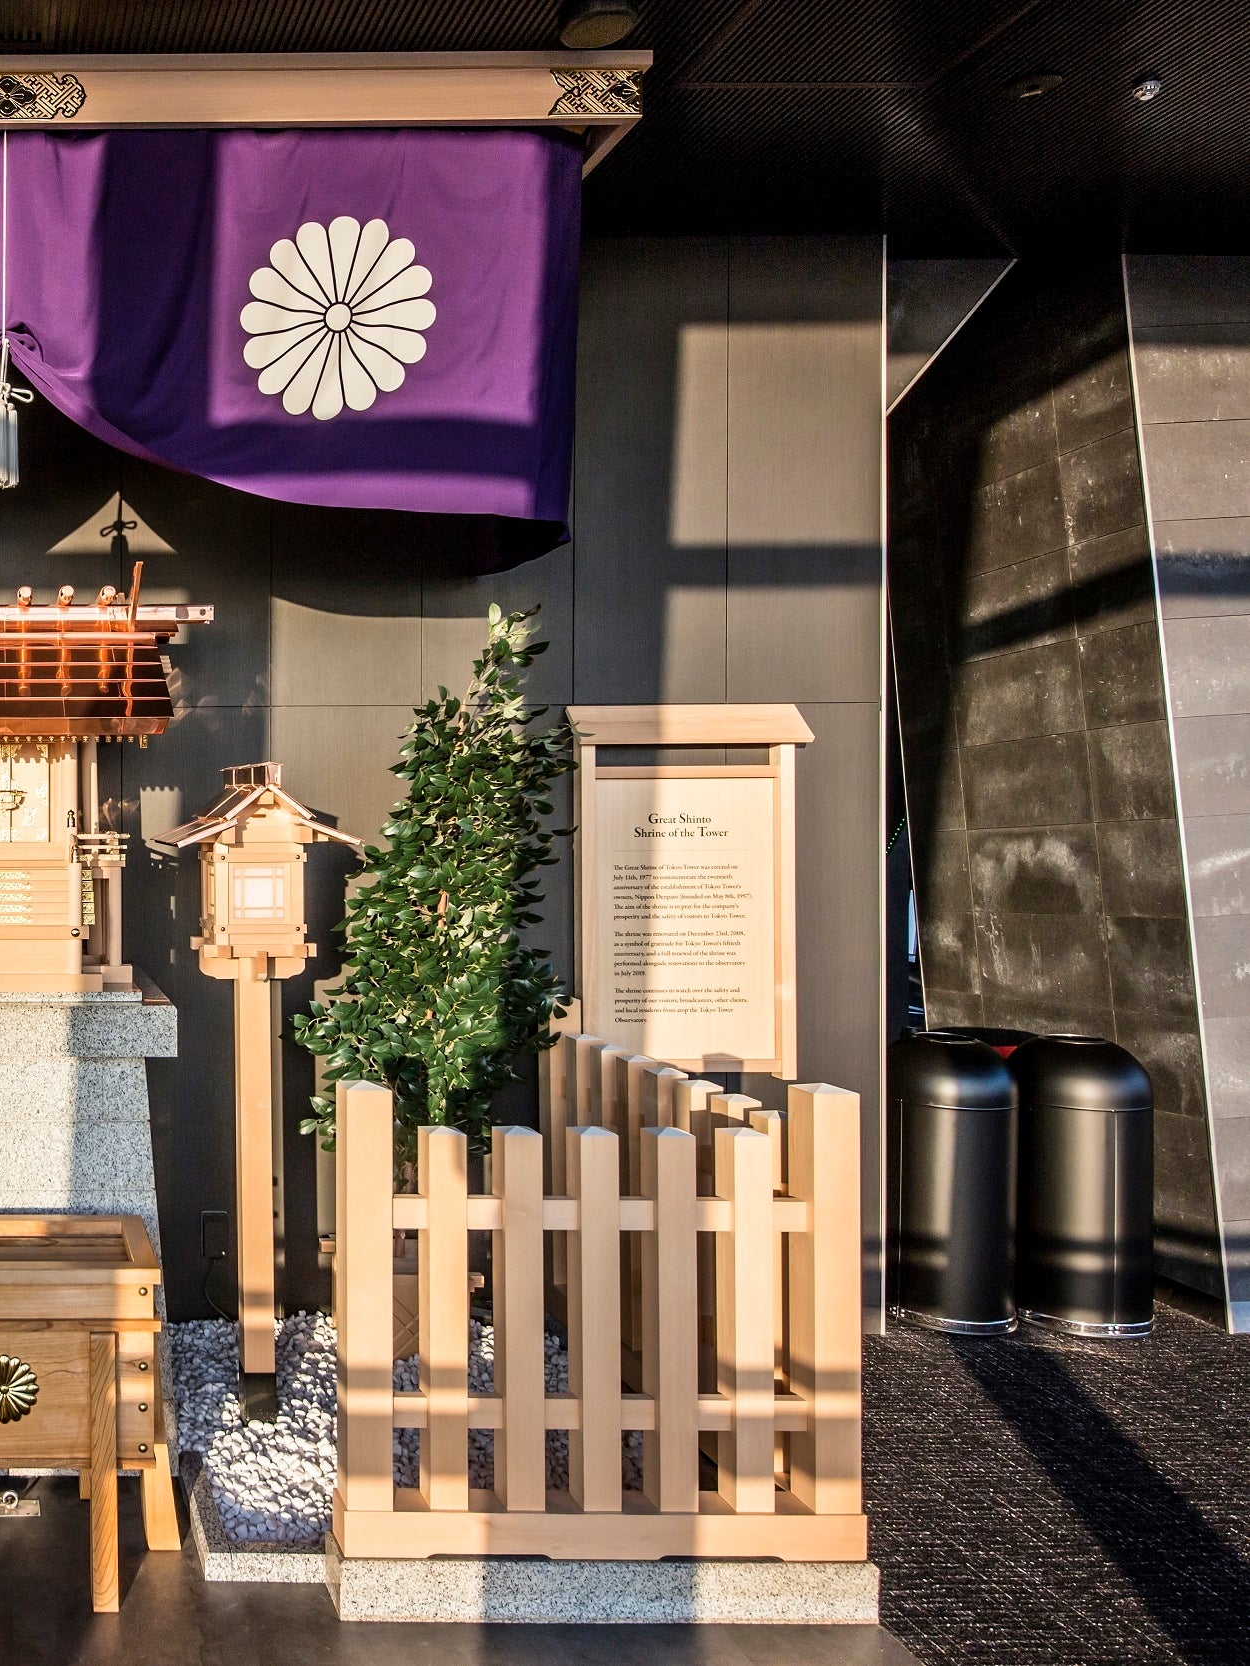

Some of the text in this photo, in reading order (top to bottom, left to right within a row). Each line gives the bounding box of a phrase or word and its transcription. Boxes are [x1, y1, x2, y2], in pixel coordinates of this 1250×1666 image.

[648, 812, 712, 824] Great Shinto
[634, 826, 728, 838] Shrine of the Tower
